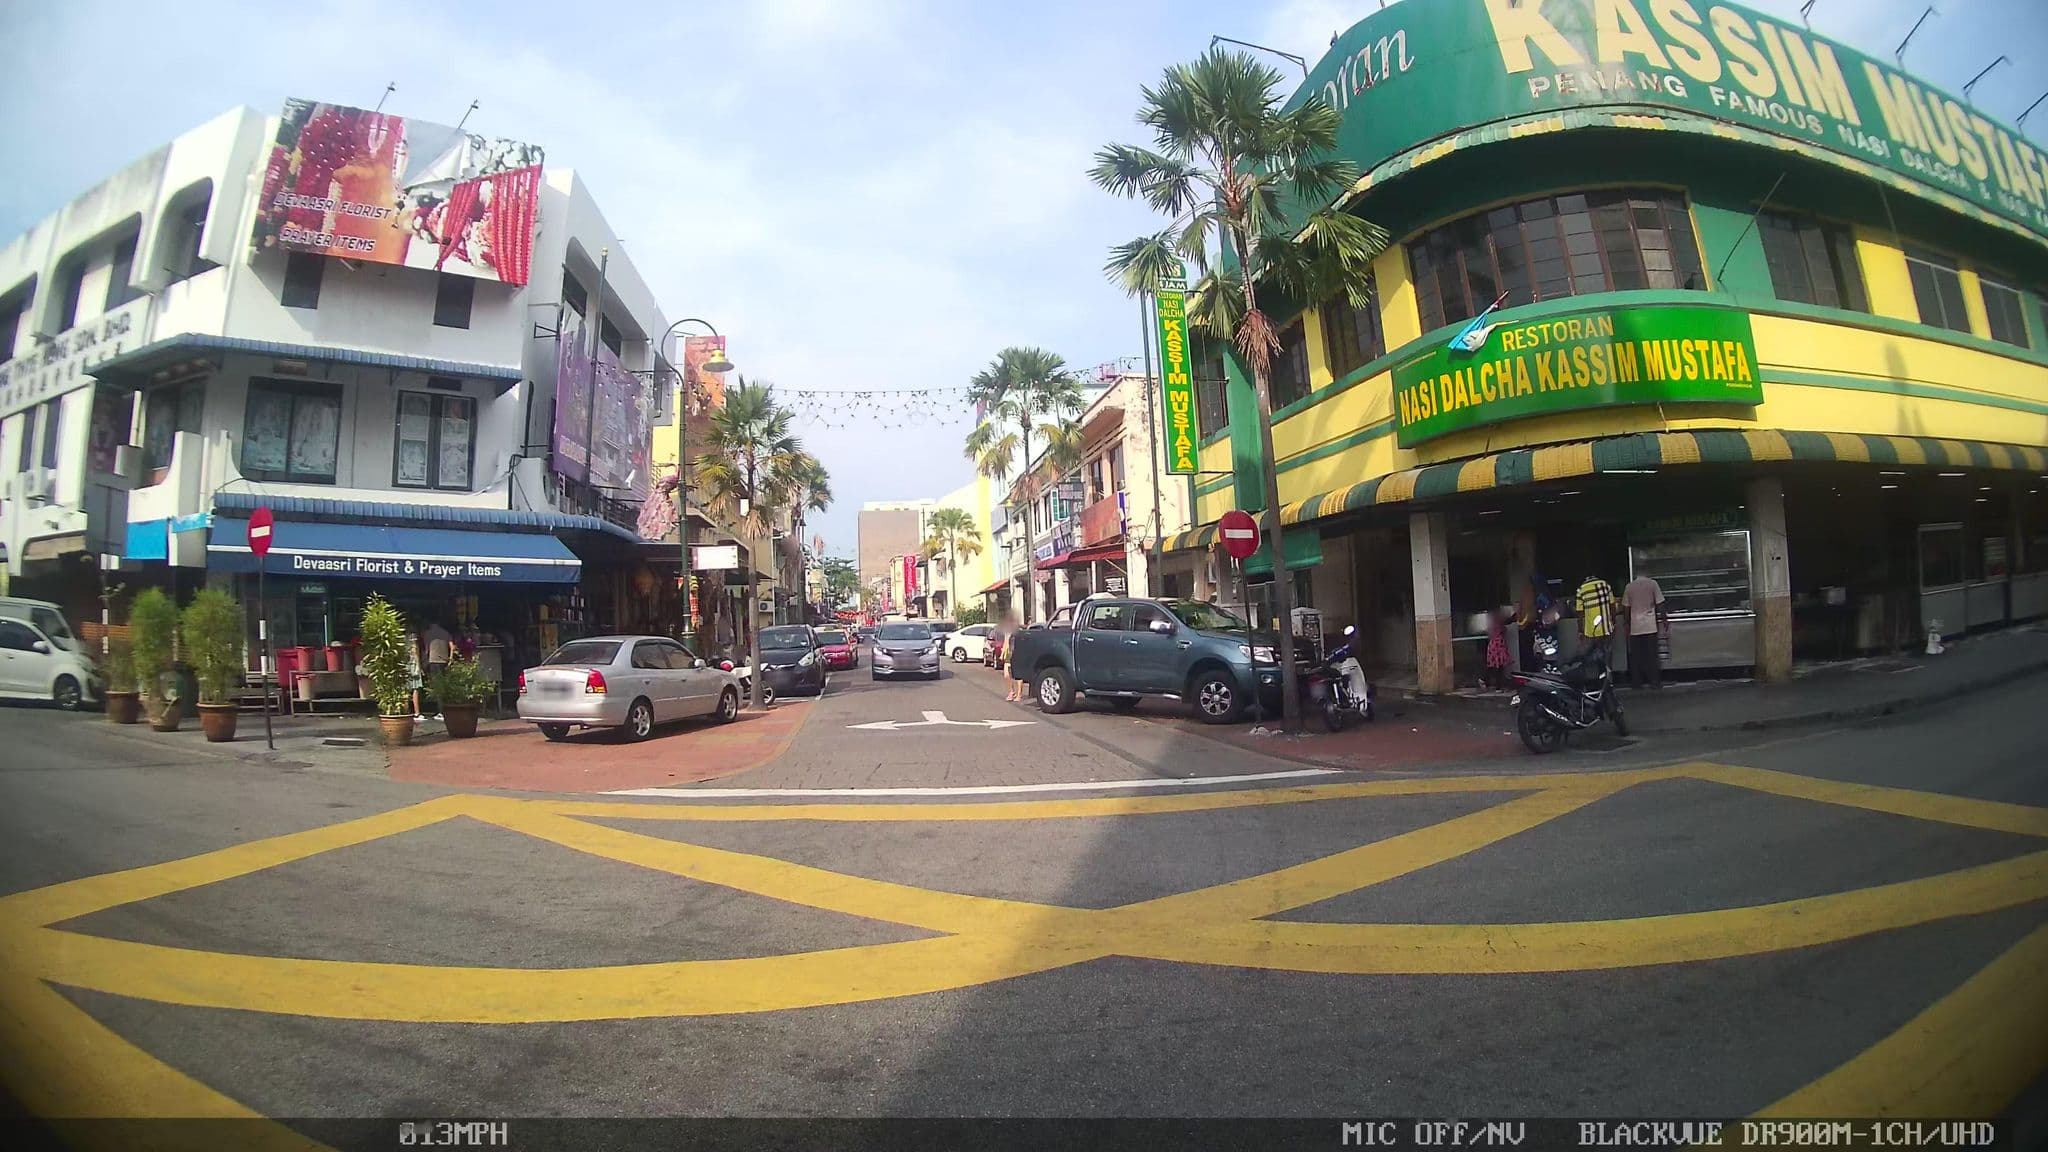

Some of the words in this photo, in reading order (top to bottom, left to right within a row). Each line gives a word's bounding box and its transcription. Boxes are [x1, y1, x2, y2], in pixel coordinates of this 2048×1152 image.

[1483, 0, 1862, 126] KASSIM
[1862, 58, 2048, 211] MUSTAF
[1527, 69, 1688, 99] PENANG
[1709, 85, 1824, 136] FAMOUS
[1837, 124, 1892, 160] NASI
[273, 191, 337, 212] DEVAASRI
[340, 202, 392, 220] FLORIST
[280, 227, 332, 248] PRAYER
[333, 237, 376, 251] ITEMS
[1164, 319, 1188, 385] KASSIM
[1502, 315, 1615, 352] RESTORAN
[1399, 378, 1439, 428] NASI
[1439, 356, 1534, 413] DALCHA
[1535, 340, 1640, 393] KASSIM
[1641, 338, 1753, 383] MUSTAFA
[1169, 390, 1194, 469] MUSTAFA
[293, 555, 351, 572] Devaasri
[355, 558, 399, 574] Florist
[403, 560, 415, 574] &
[419, 561, 463, 578] Prayer
[467, 562, 502, 577] Items
